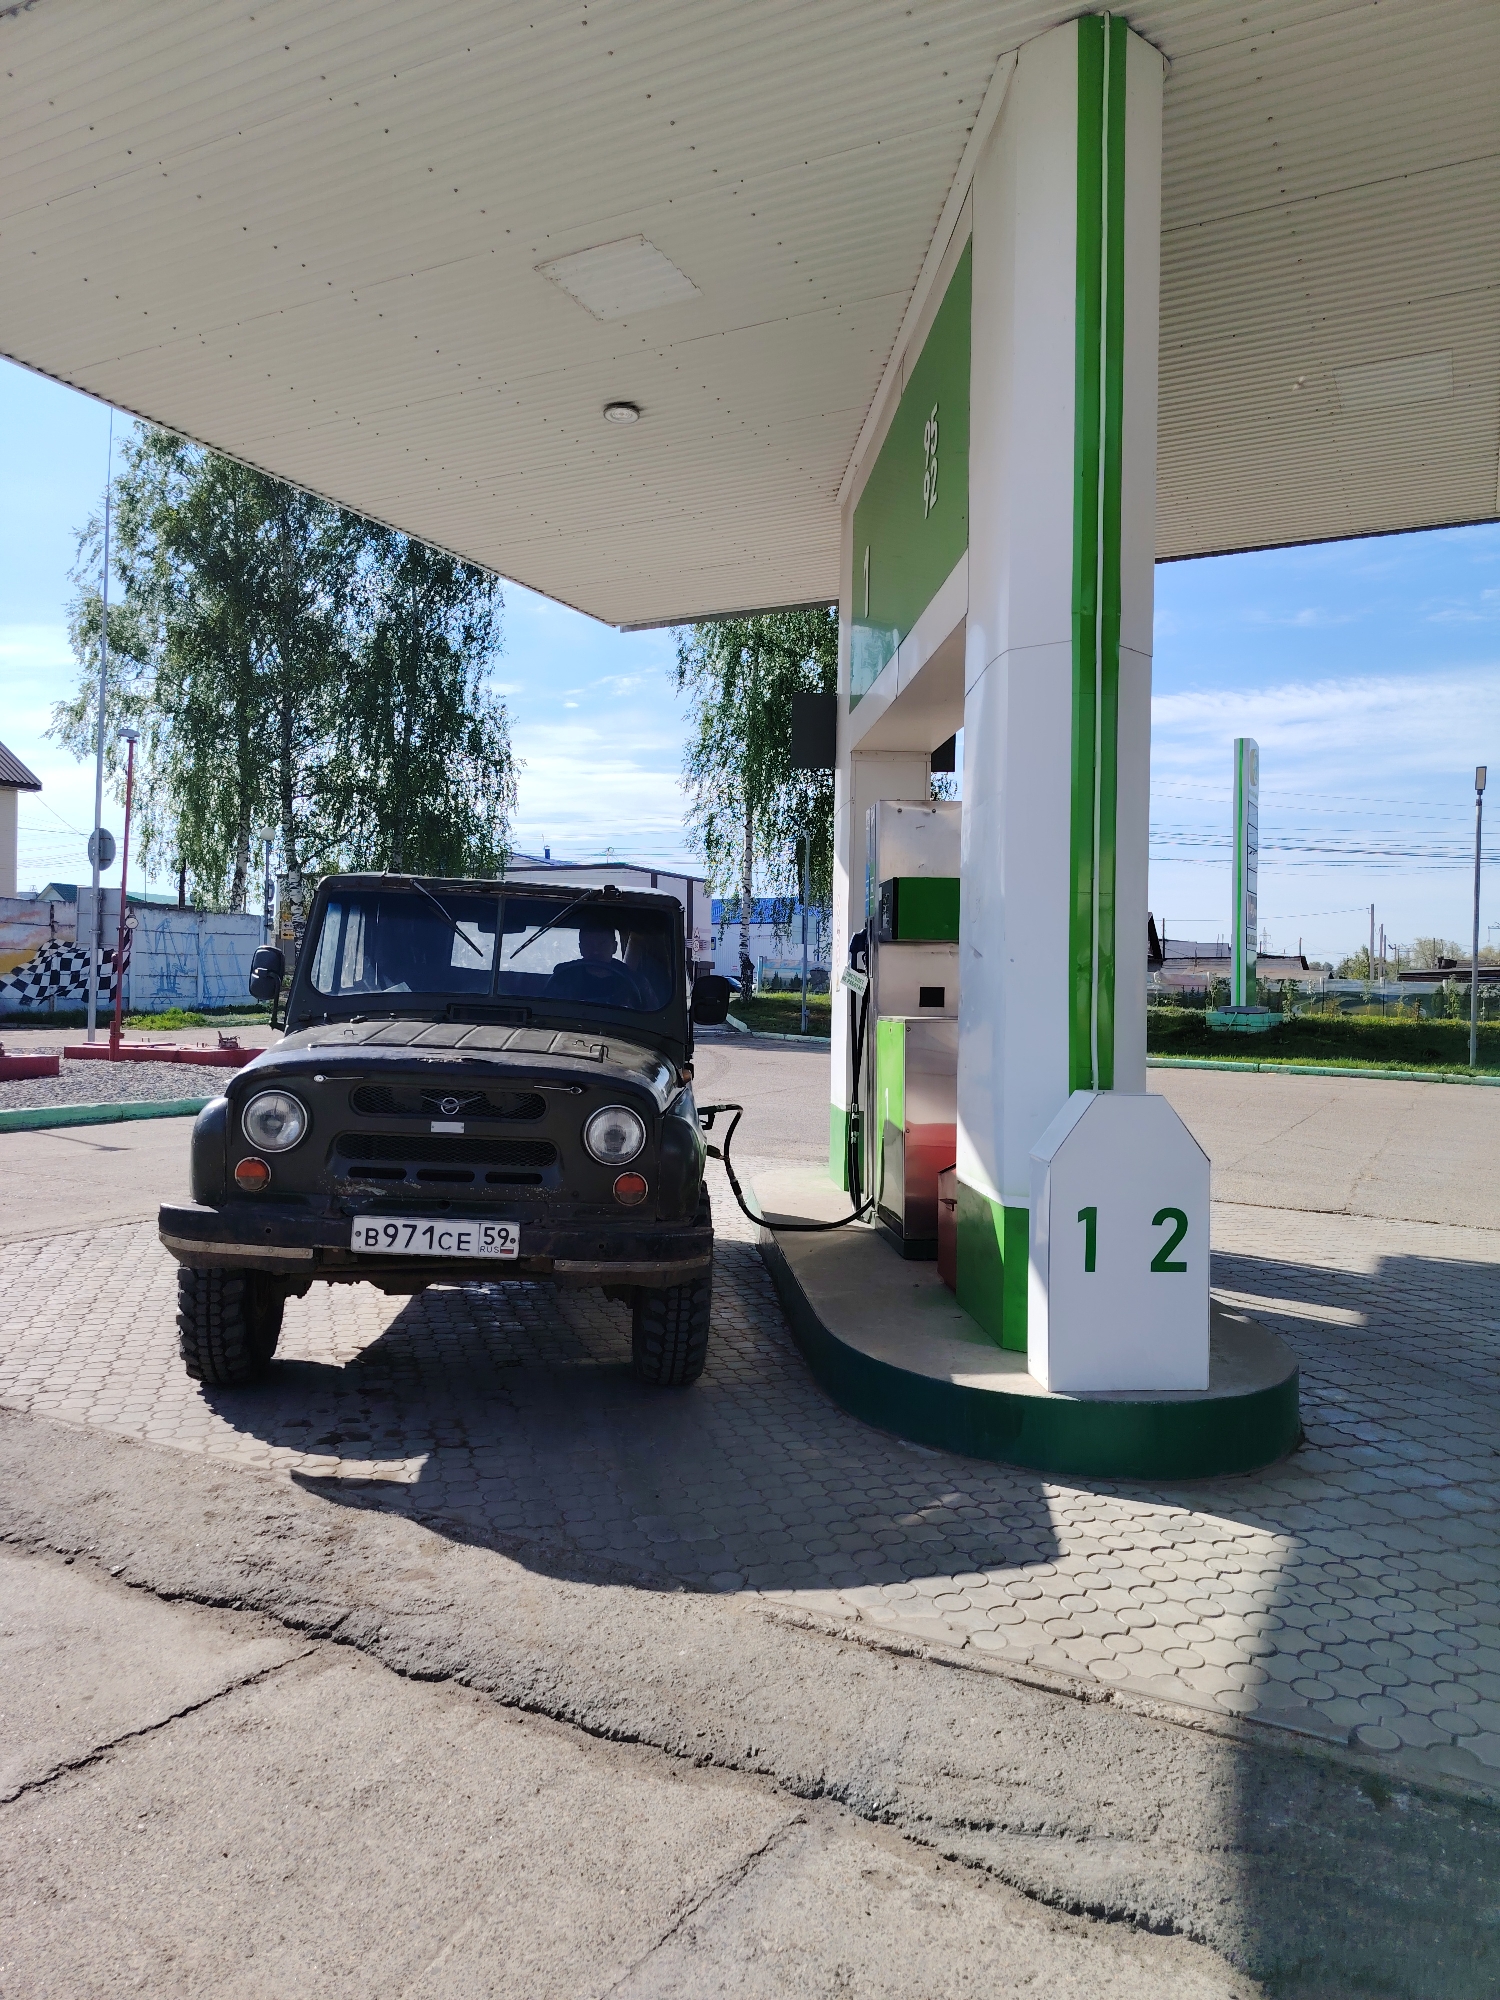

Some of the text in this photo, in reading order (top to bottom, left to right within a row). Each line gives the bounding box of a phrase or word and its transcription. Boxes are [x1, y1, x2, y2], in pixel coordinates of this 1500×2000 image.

[924, 401, 938, 469] 95
[924, 457, 938, 520] 92
[479, 1245, 500, 1254] RUS
[483, 1226, 510, 1247] 59
[1077, 1206, 1189, 1272] 1 2
